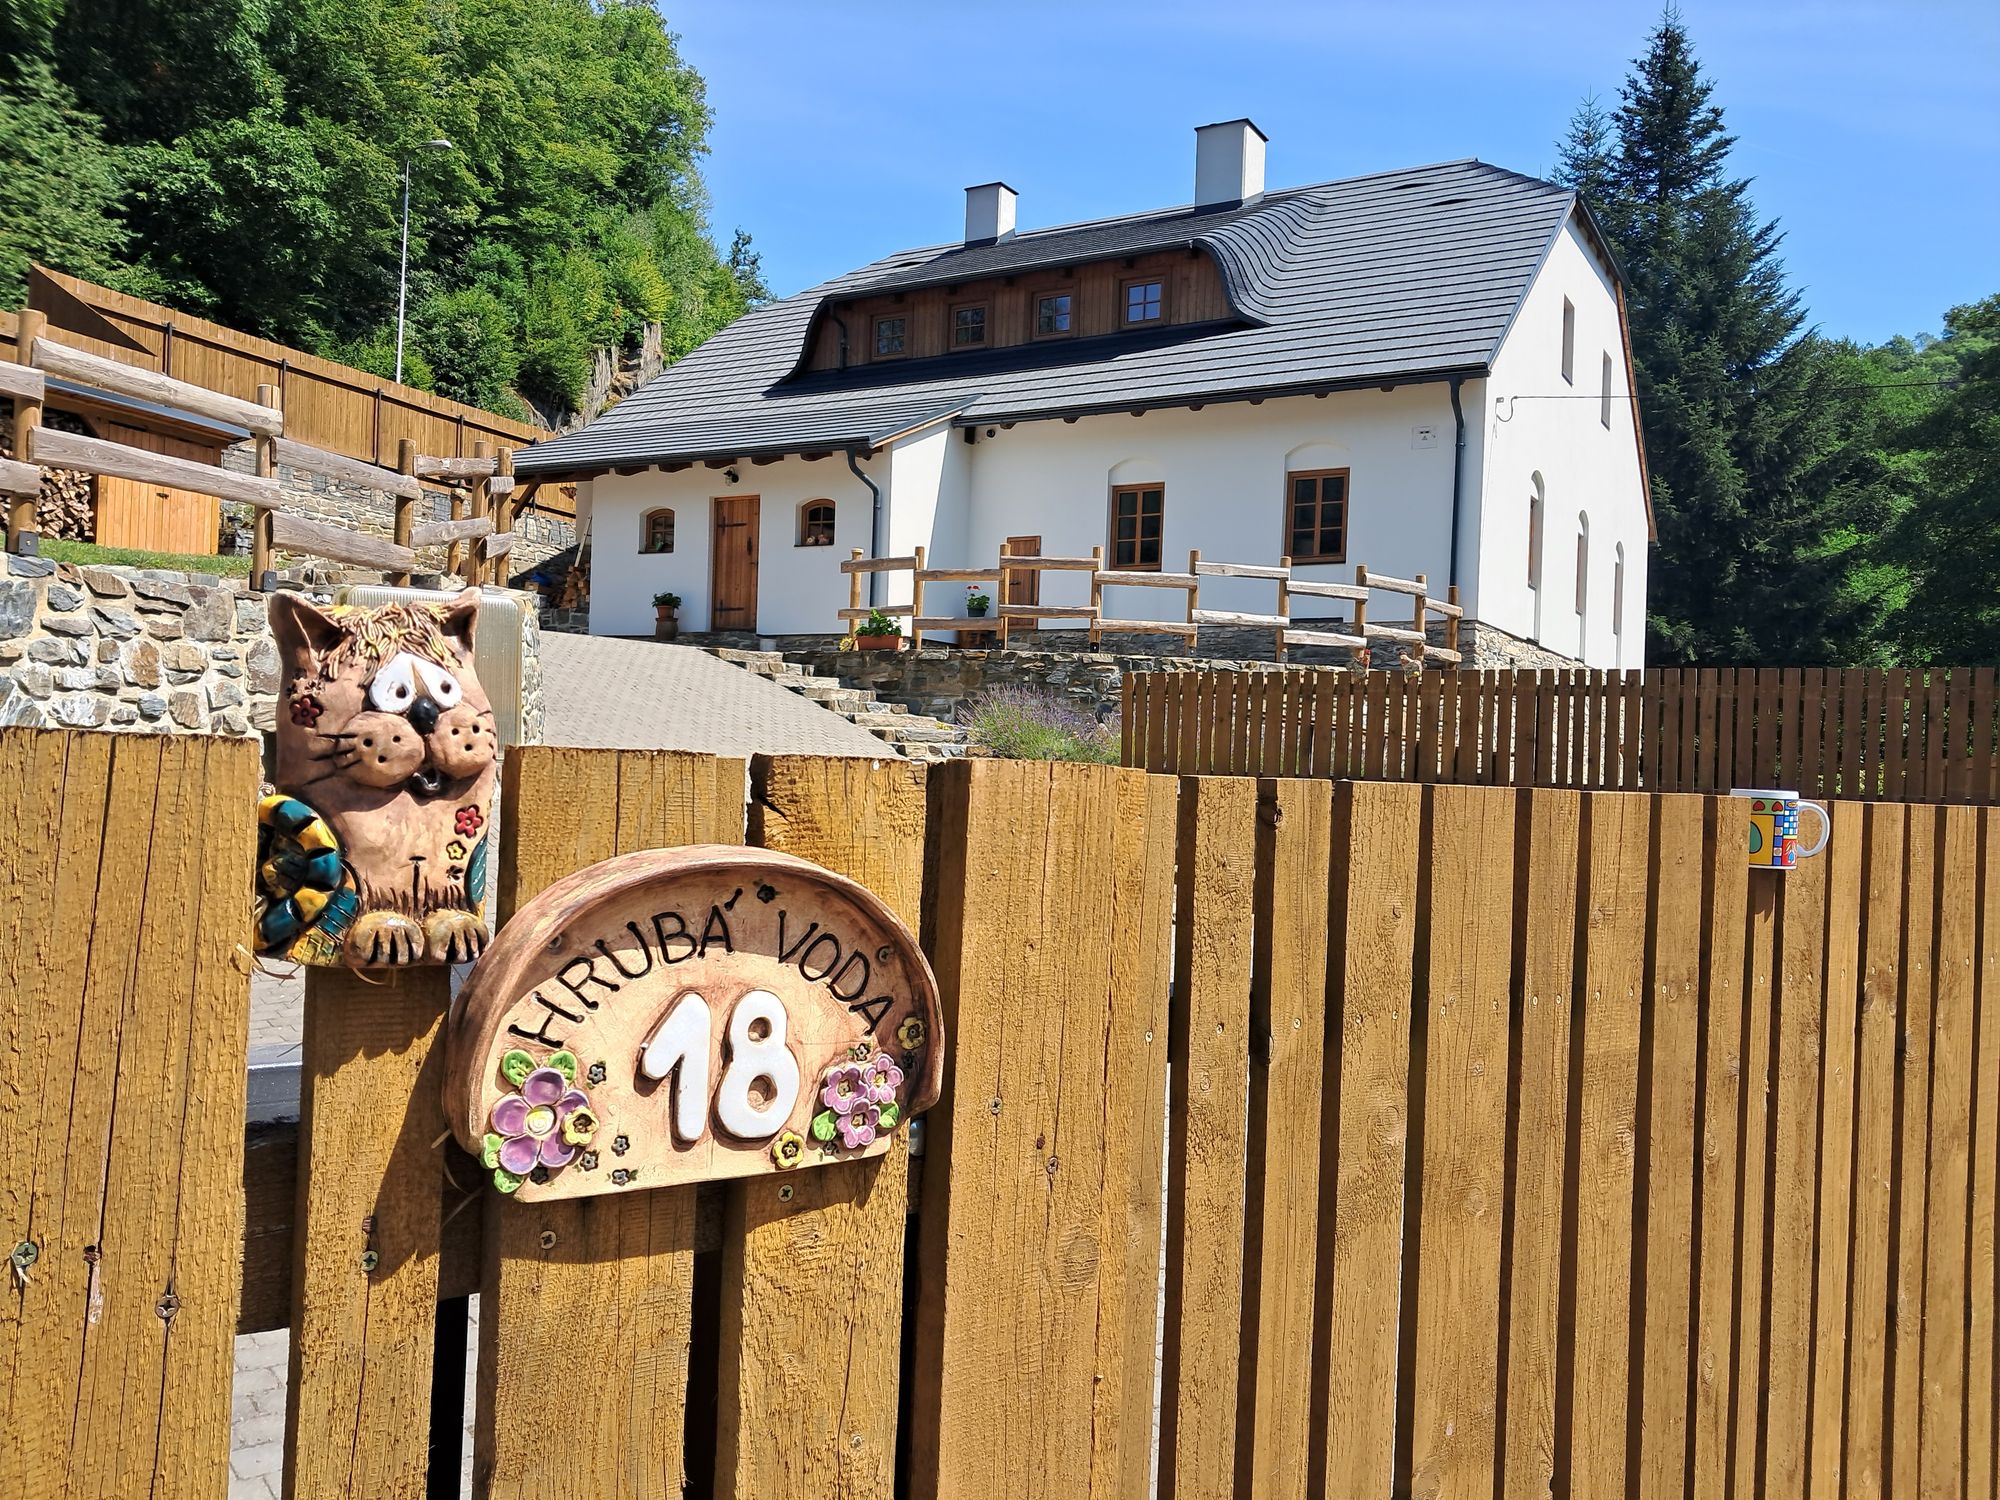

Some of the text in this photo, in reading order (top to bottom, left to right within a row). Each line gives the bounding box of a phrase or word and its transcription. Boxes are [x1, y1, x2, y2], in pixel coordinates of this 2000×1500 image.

[508, 887, 894, 1048] HRUBÁ VODA
[641, 989, 800, 1142] 18
